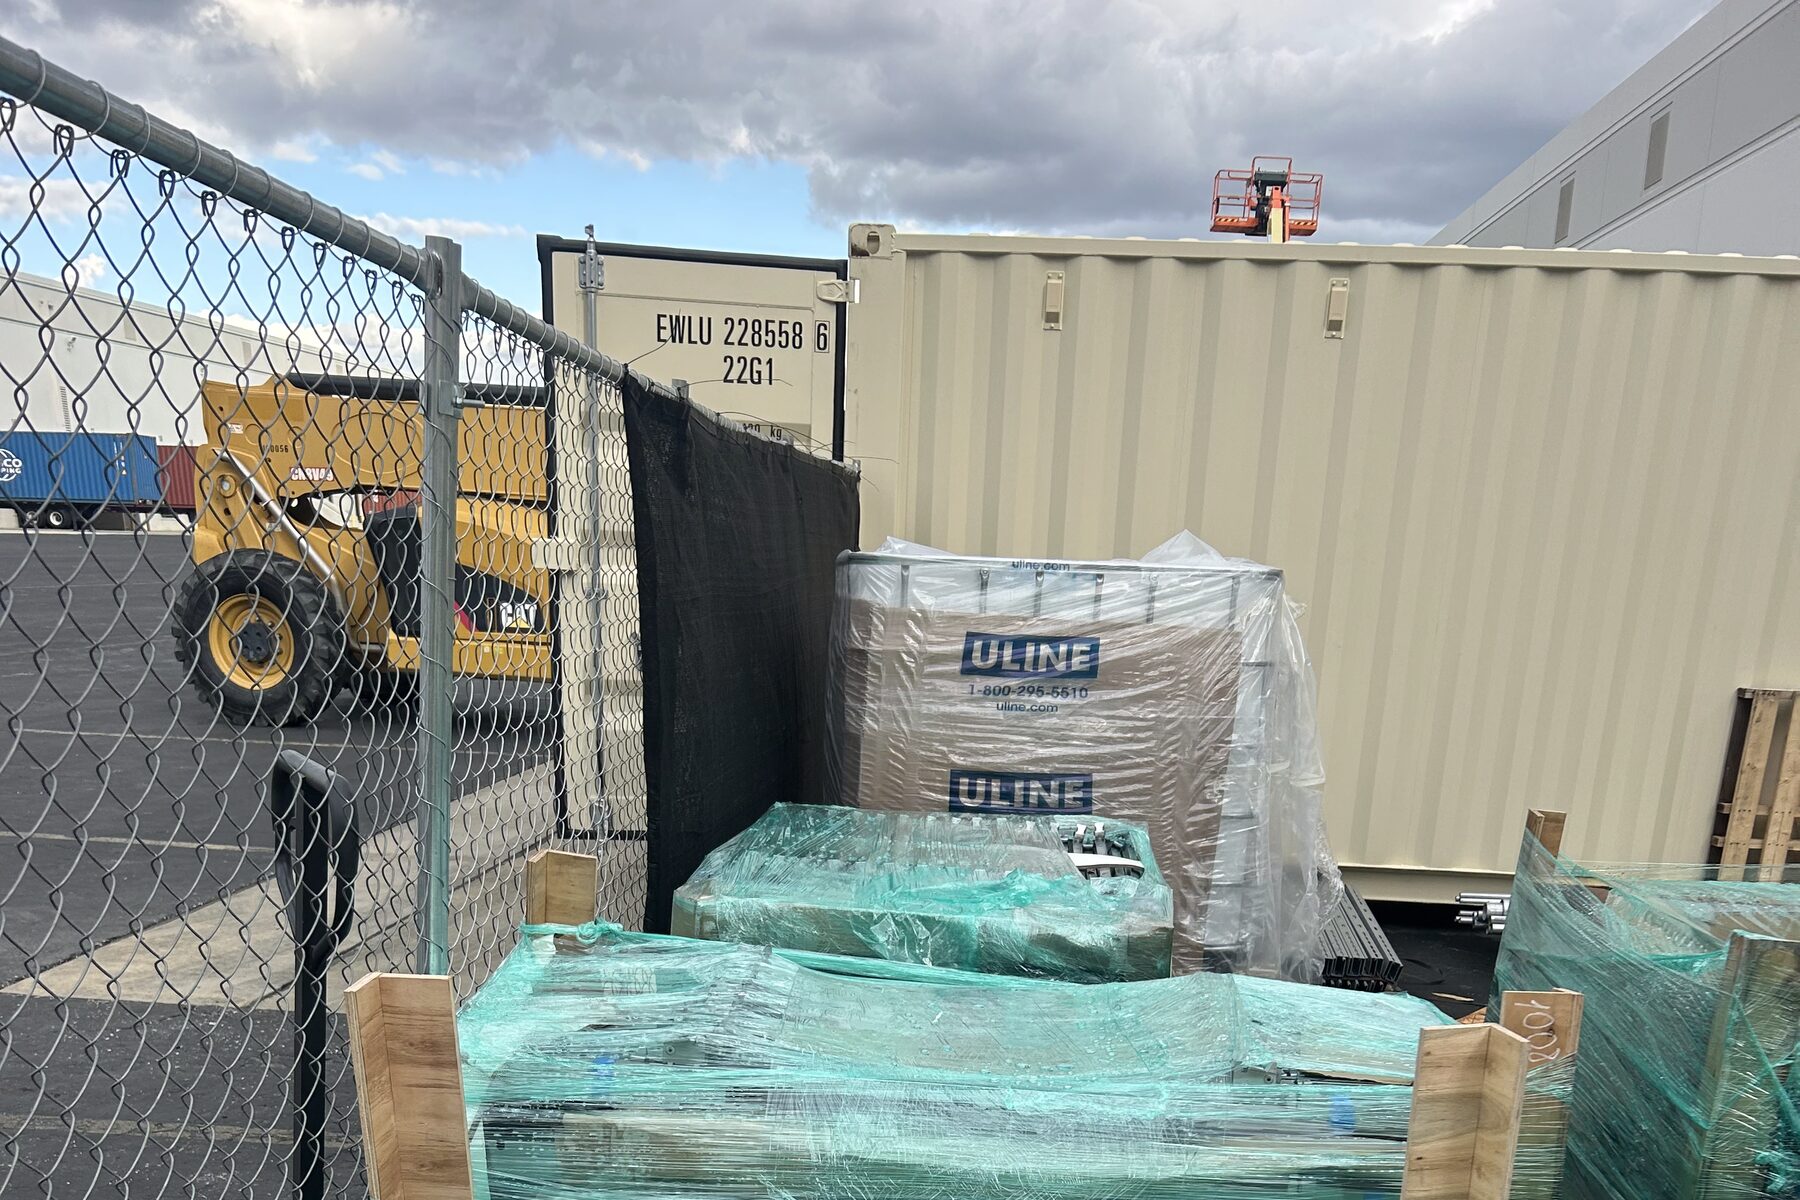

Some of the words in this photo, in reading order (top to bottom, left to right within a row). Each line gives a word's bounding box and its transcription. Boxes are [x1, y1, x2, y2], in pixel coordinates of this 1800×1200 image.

[656, 313, 712, 346] EWLU
[723, 317, 803, 350] 228558
[816, 322, 828, 351] 6
[723, 355, 774, 386] 22G1
[770, 425, 782, 440] kg
[0, 458, 22, 468] CO
[1011, 560, 1071, 572] uline.com
[500, 602, 538, 629] CAT
[970, 638, 1092, 674] ULINE
[968, 683, 1089, 699] 1-800-295-5510
[996, 701, 1059, 713] uline.com
[957, 776, 1086, 808] ULINE
